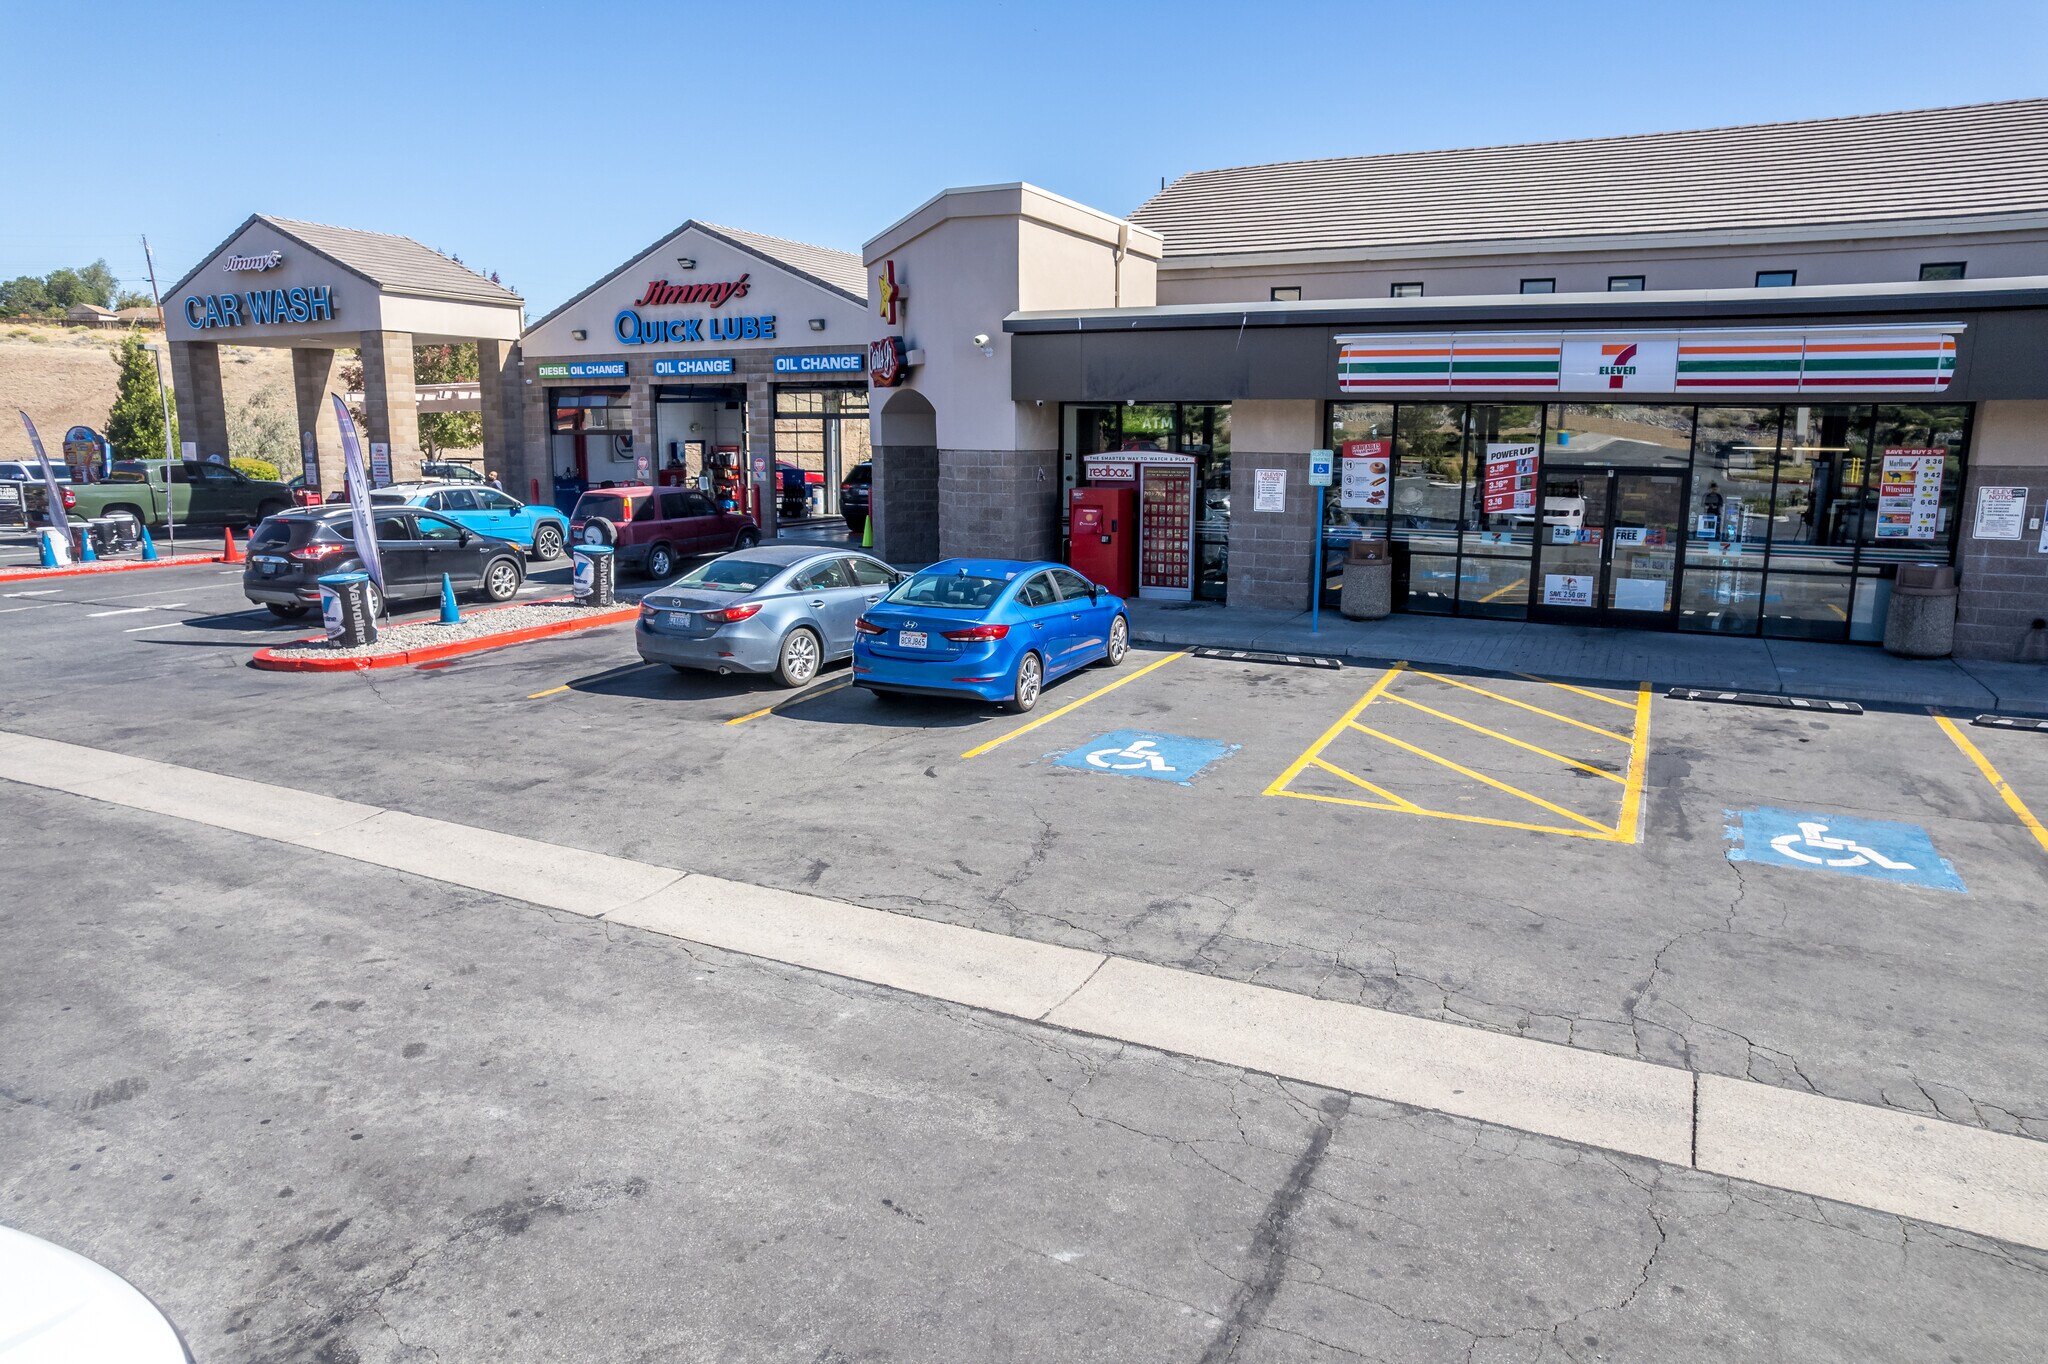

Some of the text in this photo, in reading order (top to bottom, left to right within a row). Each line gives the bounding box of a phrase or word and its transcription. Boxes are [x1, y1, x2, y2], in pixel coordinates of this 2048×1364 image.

[223, 250, 280, 272] Jimmy's
[634, 273, 750, 308] Jimmy's
[184, 286, 331, 330] CAR WASH
[614, 309, 776, 345] QUICK LUBE
[539, 364, 624, 376] DIESEL OIL CHANGE
[655, 360, 730, 374] OIL CHANGE
[776, 356, 859, 371] OIL CHANGE
[1602, 344, 1637, 389] 7
[1142, 417, 1173, 430] ATM
[1491, 446, 1534, 460] POWER UP
[1885, 485, 1911, 493] Winston
[1616, 532, 1637, 540] FREE
[348, 583, 366, 644] Valvoline
